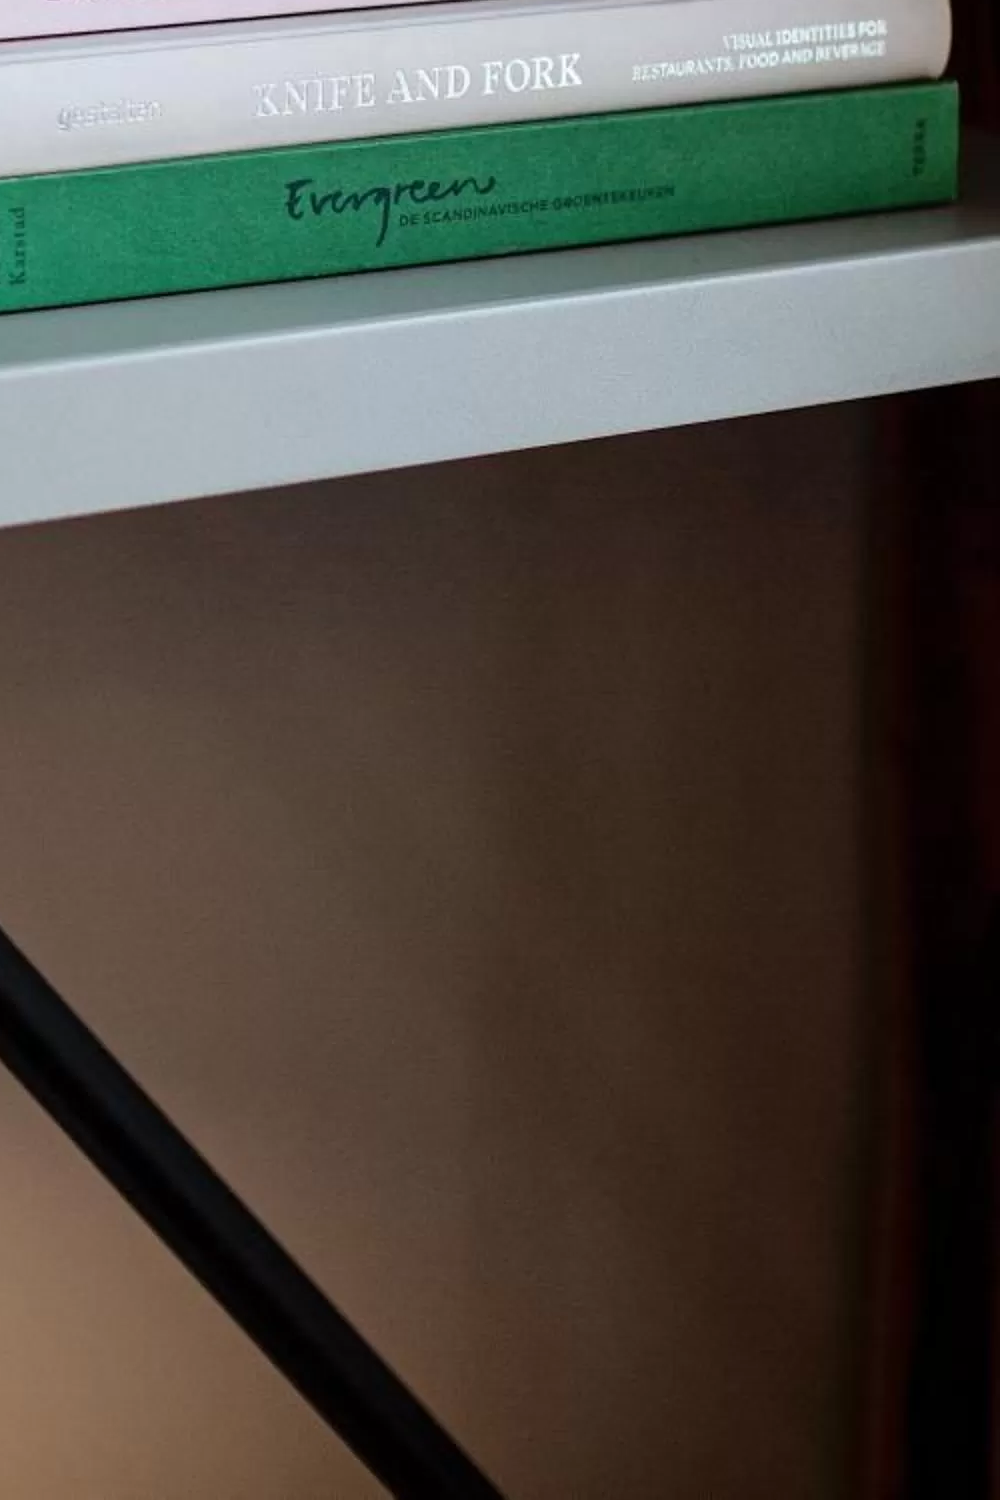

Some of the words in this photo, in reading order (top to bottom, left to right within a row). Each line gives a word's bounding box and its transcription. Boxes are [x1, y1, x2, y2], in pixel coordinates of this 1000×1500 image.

[723, 31, 773, 51] VISUAL
[774, 22, 858, 47] IDENTITIES
[858, 19, 888, 38] FOR
[738, 51, 779, 71] FOOD
[781, 46, 814, 65] AND
[252, 72, 377, 117] KNIFE
[386, 63, 471, 104] AND
[482, 52, 583, 96] FORK
[284, 175, 497, 247] Evergreen
[399, 212, 420, 227] DE
[423, 199, 548, 225] SCANDINAVISCHE
